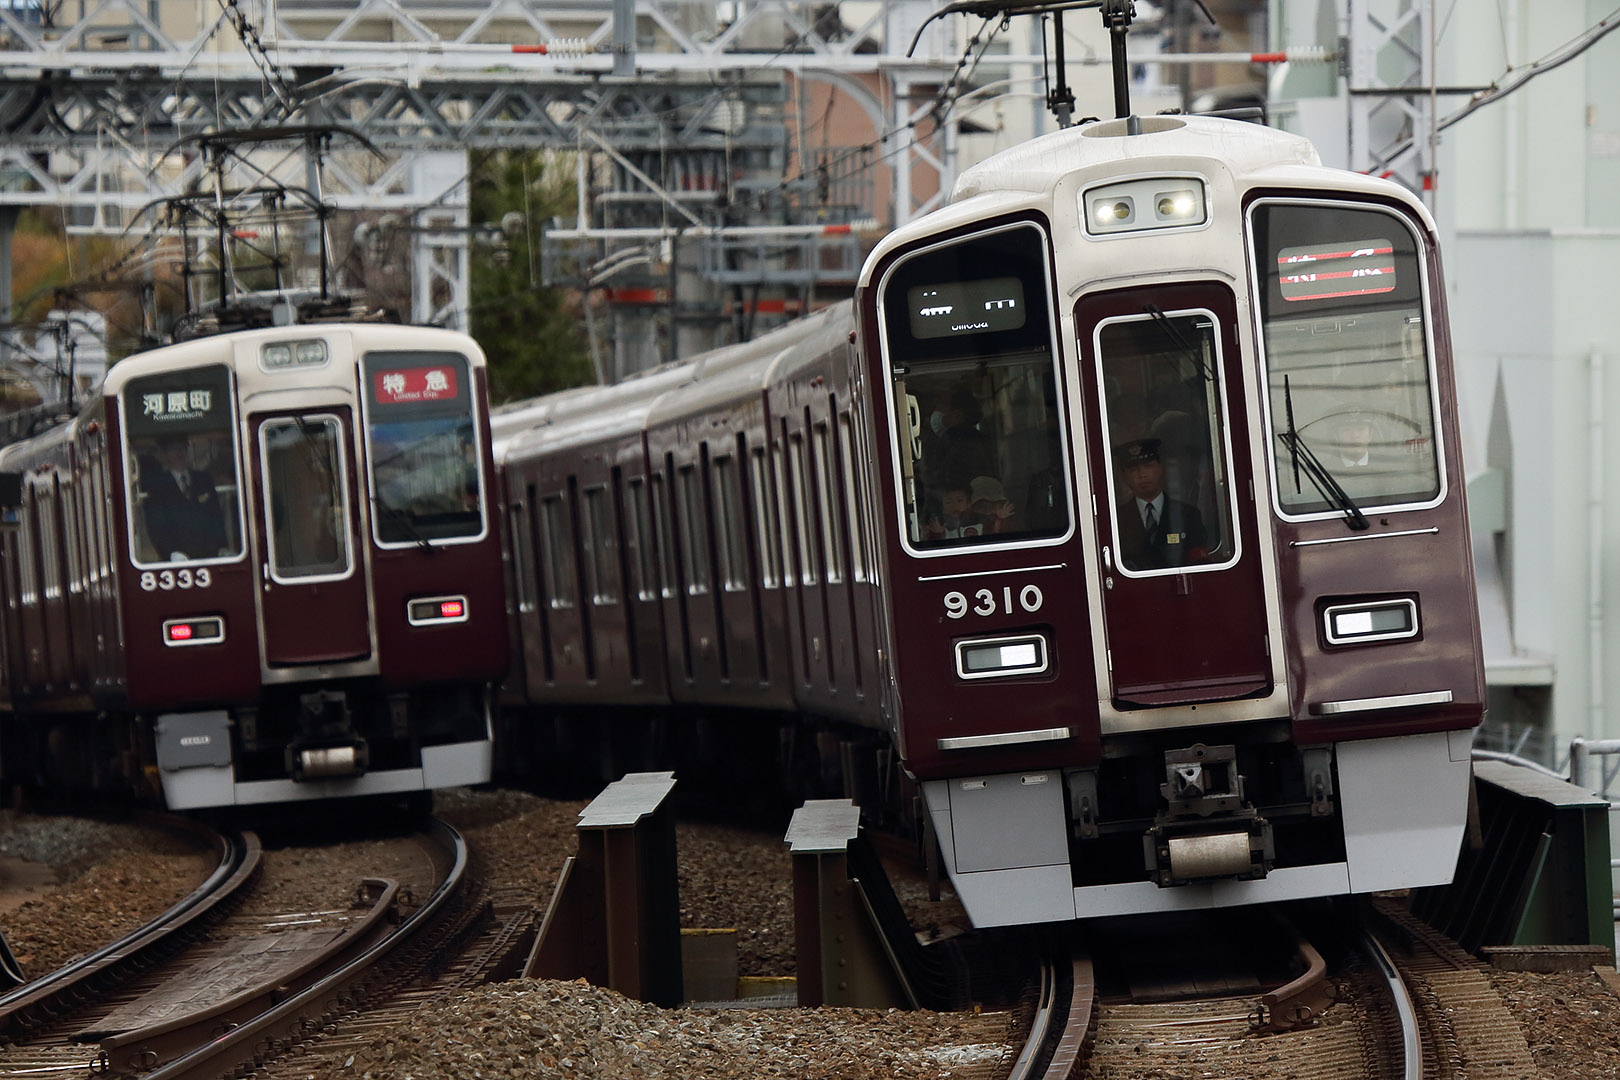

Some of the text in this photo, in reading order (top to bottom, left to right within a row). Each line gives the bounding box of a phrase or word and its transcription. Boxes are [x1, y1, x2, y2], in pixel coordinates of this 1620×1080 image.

[383, 370, 448, 394] 特急
[143, 390, 212, 416] 河原町
[140, 568, 211, 592] 8333
[943, 584, 1043, 619] 9310
